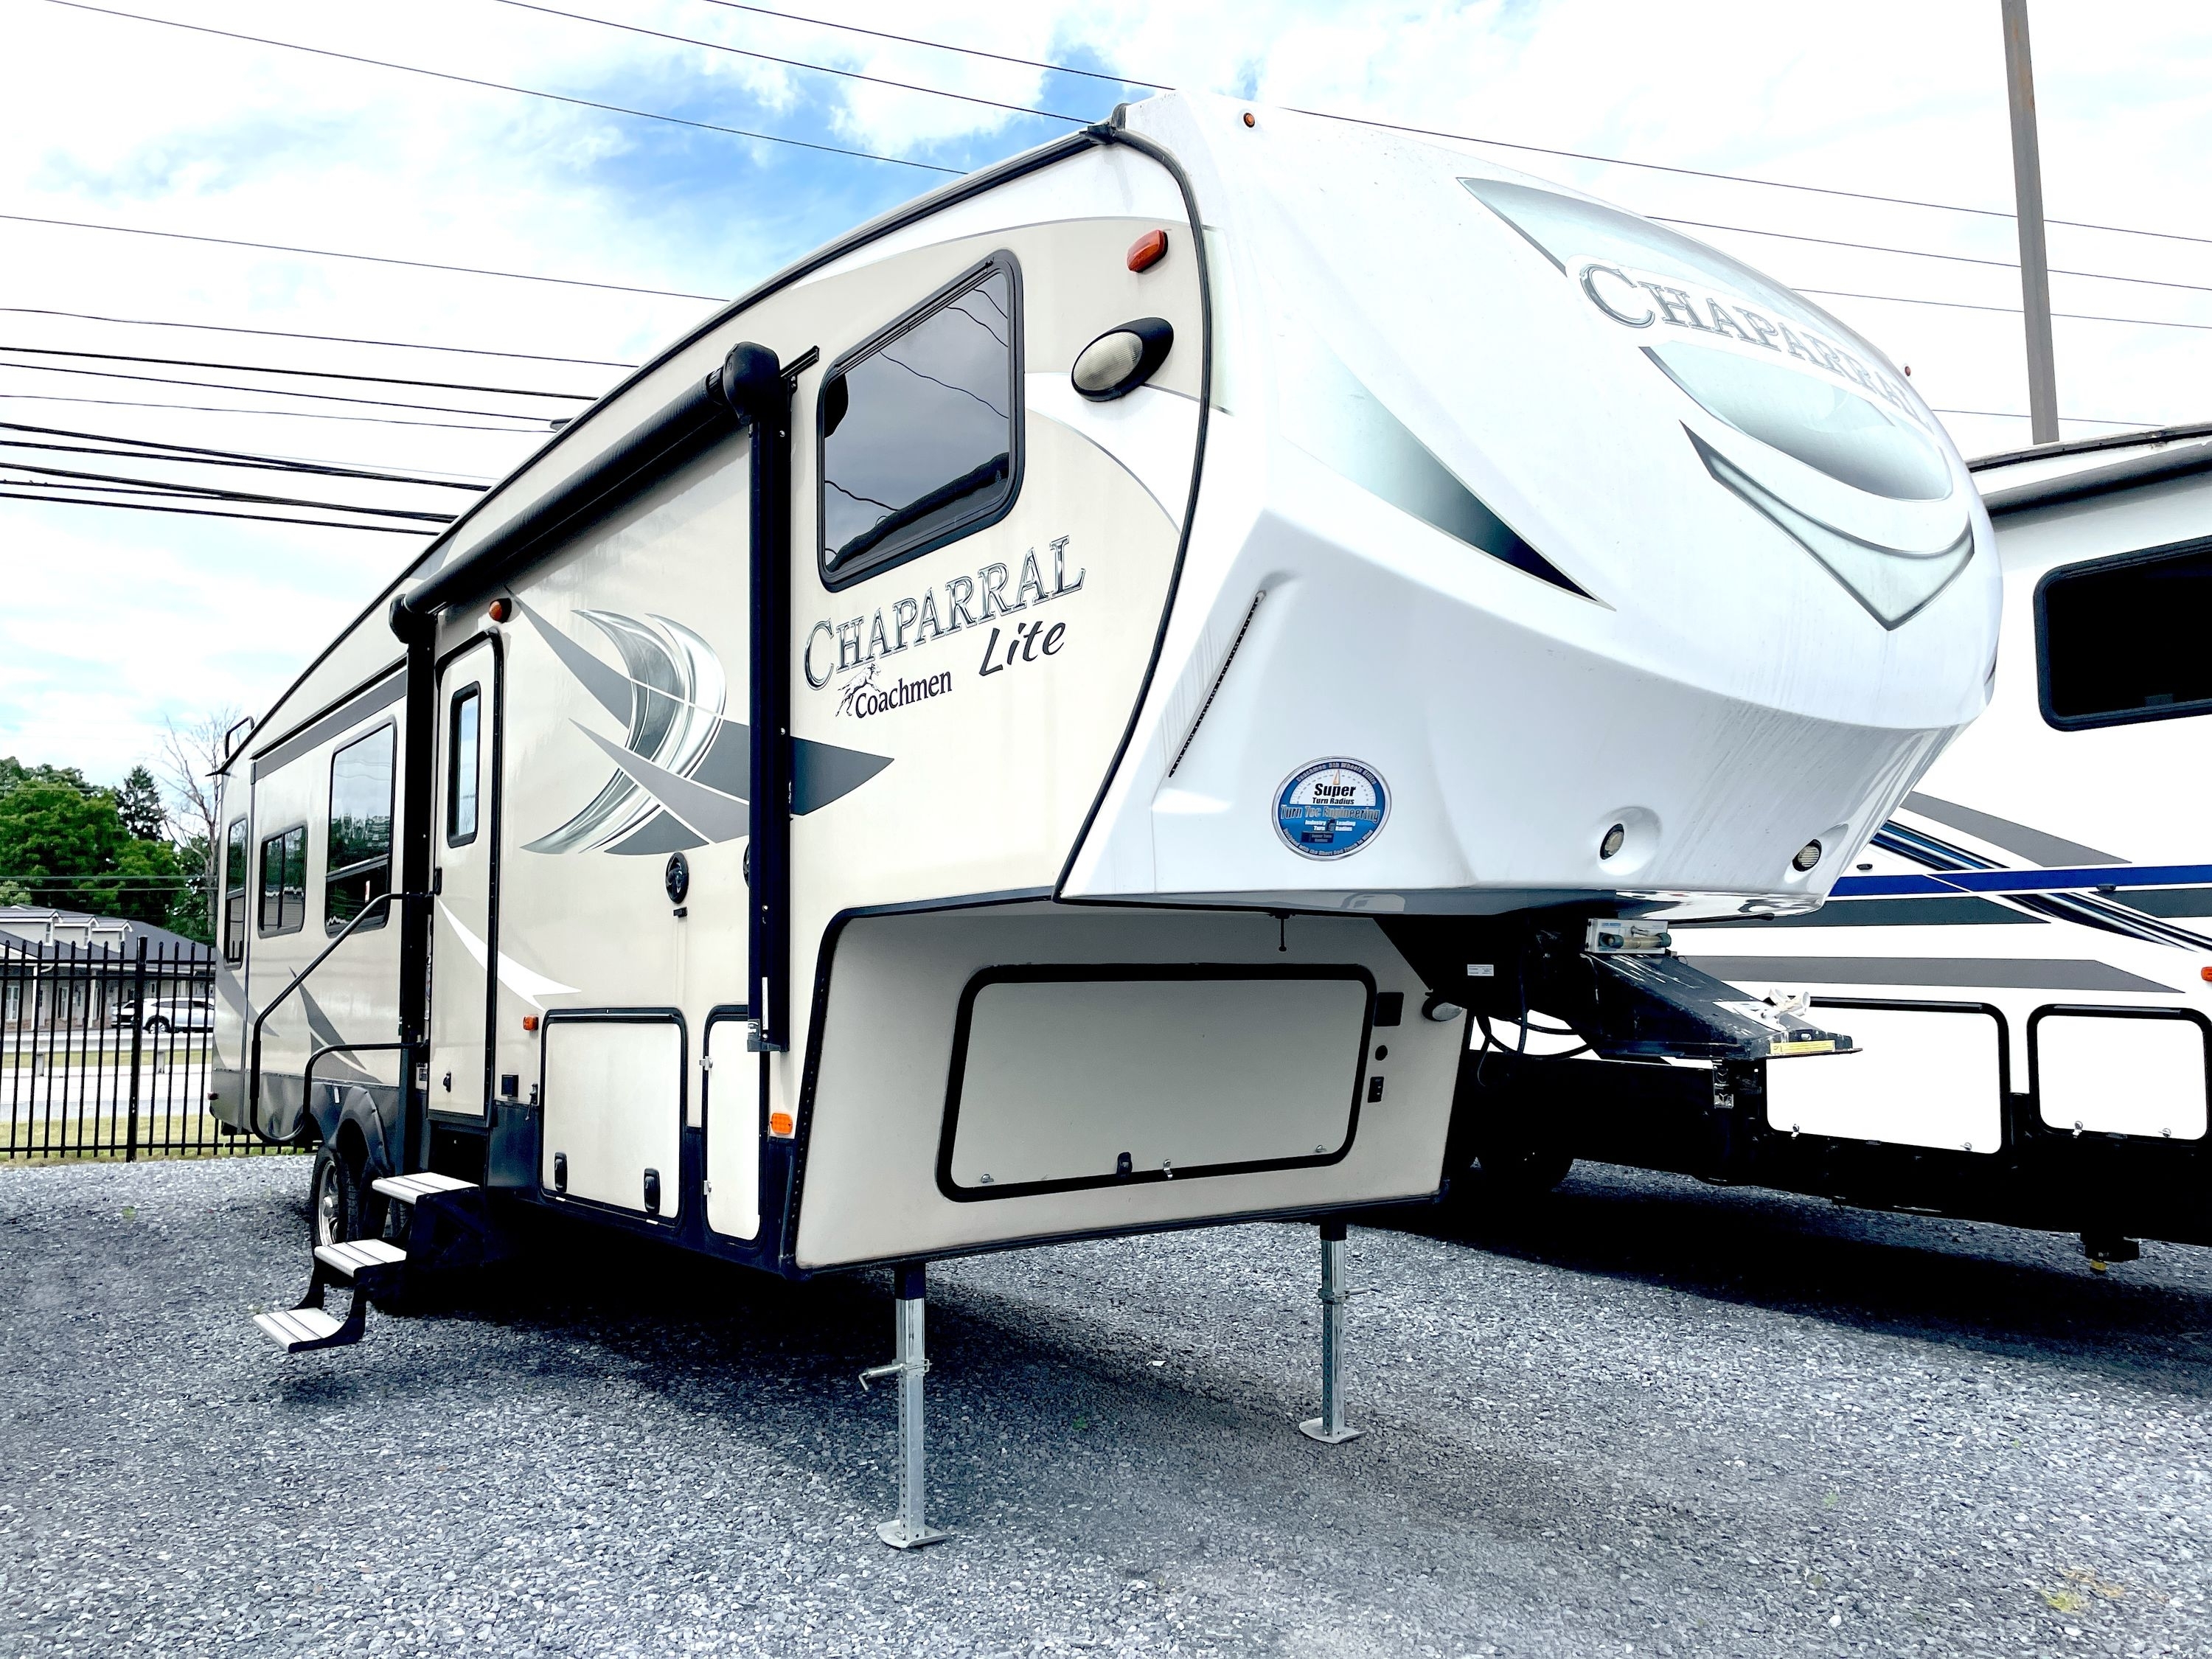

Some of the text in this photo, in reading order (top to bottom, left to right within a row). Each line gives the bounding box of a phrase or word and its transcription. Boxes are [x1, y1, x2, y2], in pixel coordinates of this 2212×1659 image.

[1579, 263, 1935, 435] CHAPARRAL
[803, 535, 1086, 691] CHAPARRAL
[978, 620, 1065, 676] Lite
[855, 670, 952, 719] Coachmen
[1281, 804, 1302, 820] Turn
[1323, 806, 1381, 824] Engineering
[1314, 783, 1357, 797] Super
